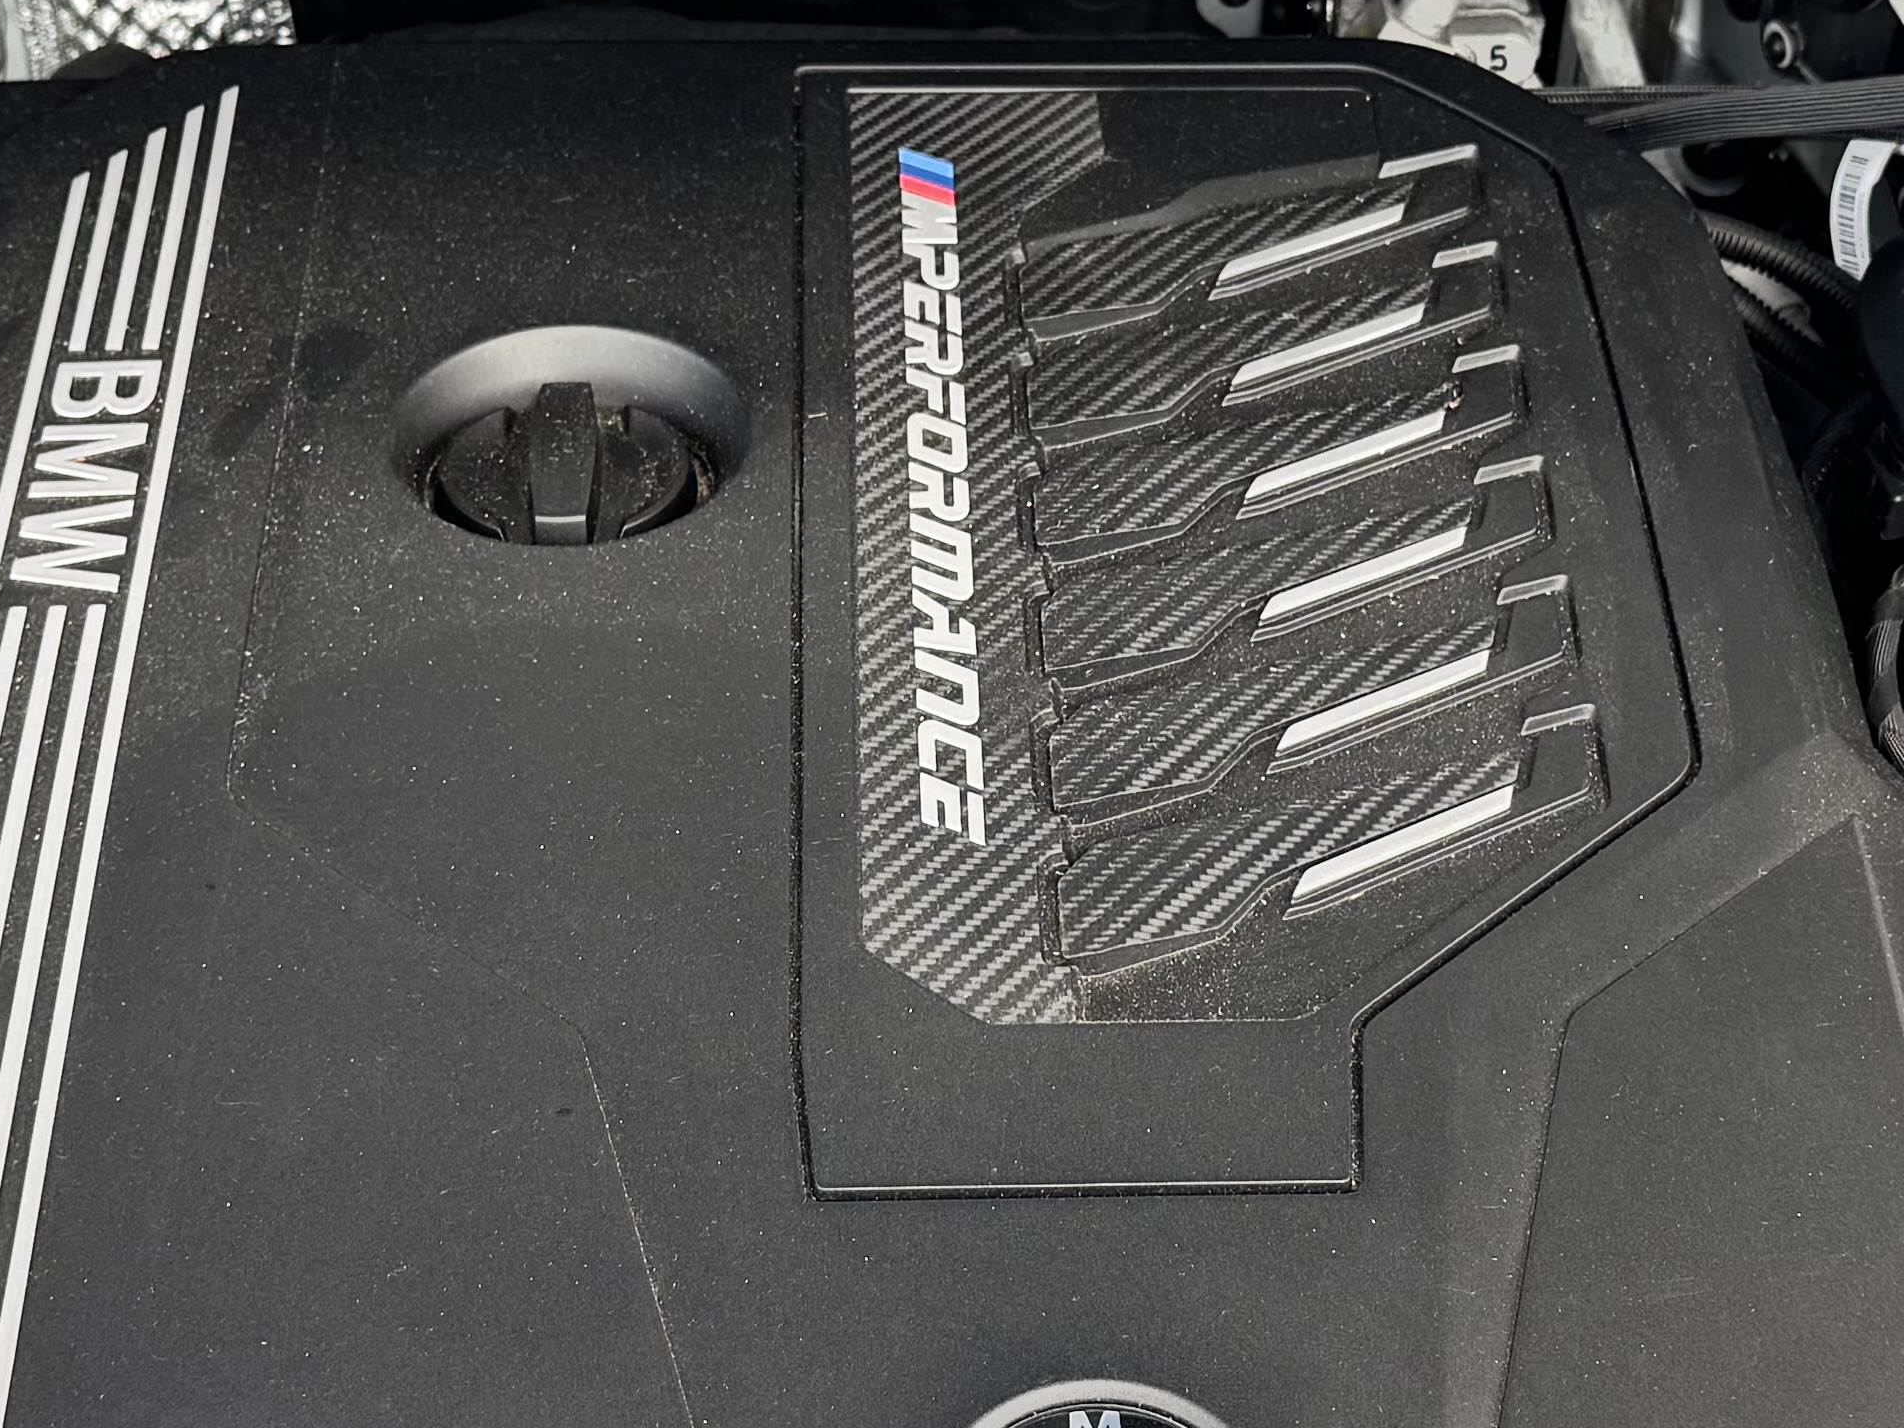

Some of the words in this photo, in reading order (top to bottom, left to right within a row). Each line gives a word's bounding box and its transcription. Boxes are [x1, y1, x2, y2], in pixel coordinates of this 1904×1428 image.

[1490, 45, 1508, 72] 5
[9, 359, 163, 594] BMW
[901, 235, 987, 847] PERFORMANCE
